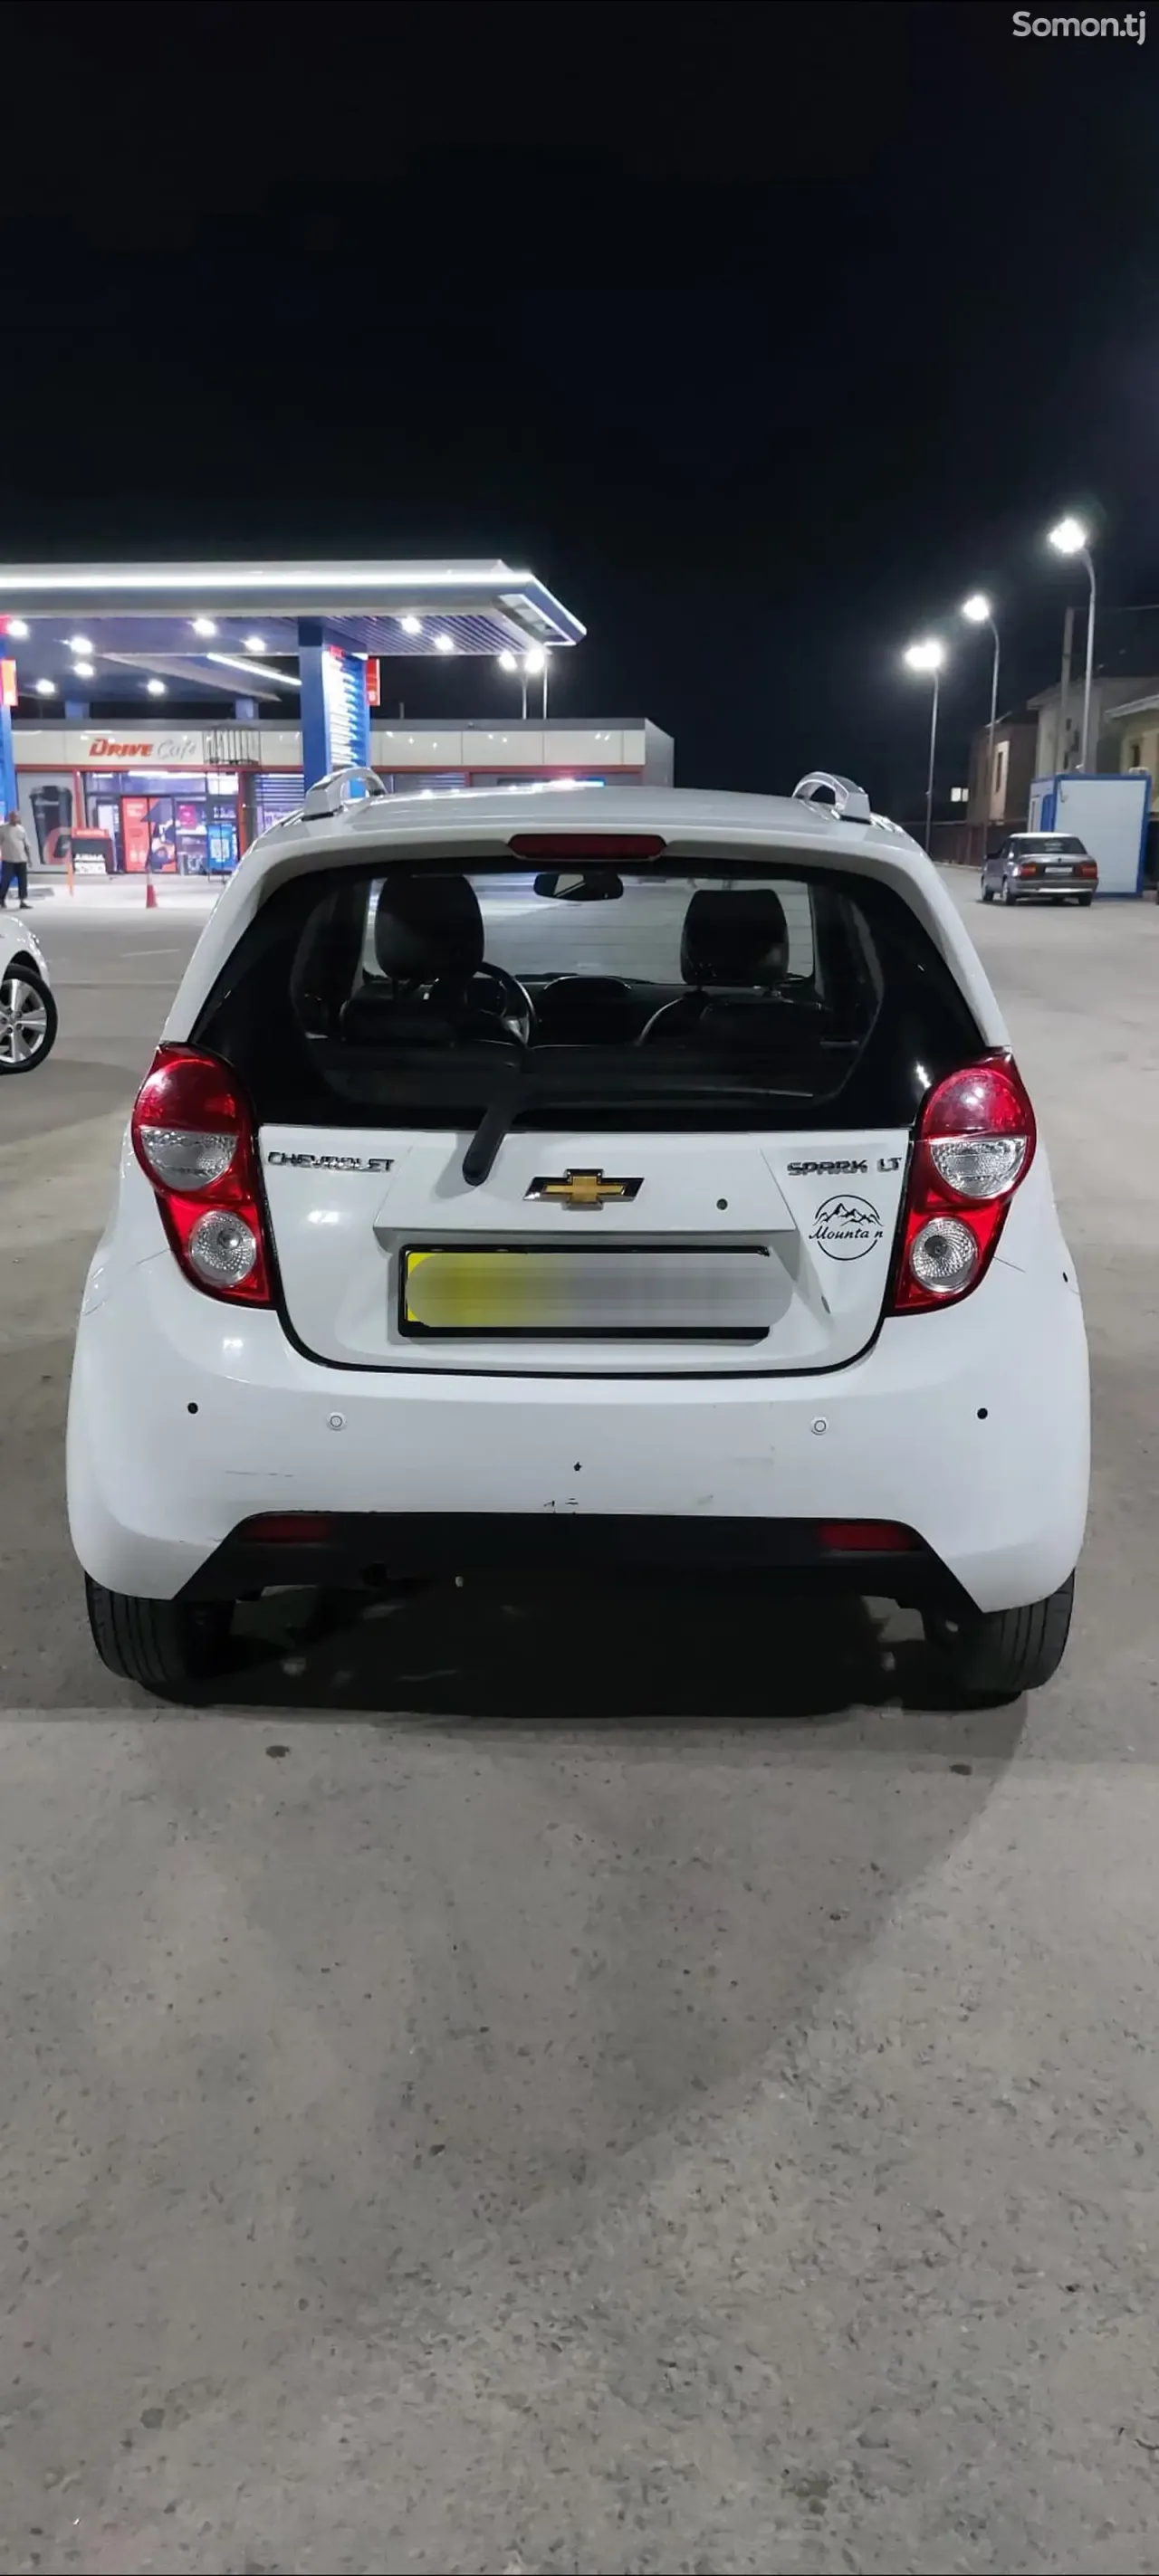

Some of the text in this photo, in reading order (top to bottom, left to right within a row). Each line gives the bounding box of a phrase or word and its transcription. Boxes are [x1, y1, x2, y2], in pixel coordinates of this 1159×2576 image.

[89, 738, 153, 757] DRIVE
[268, 1151, 395, 1172] CHEVROLET
[787, 1157, 902, 1176] SPARK LT
